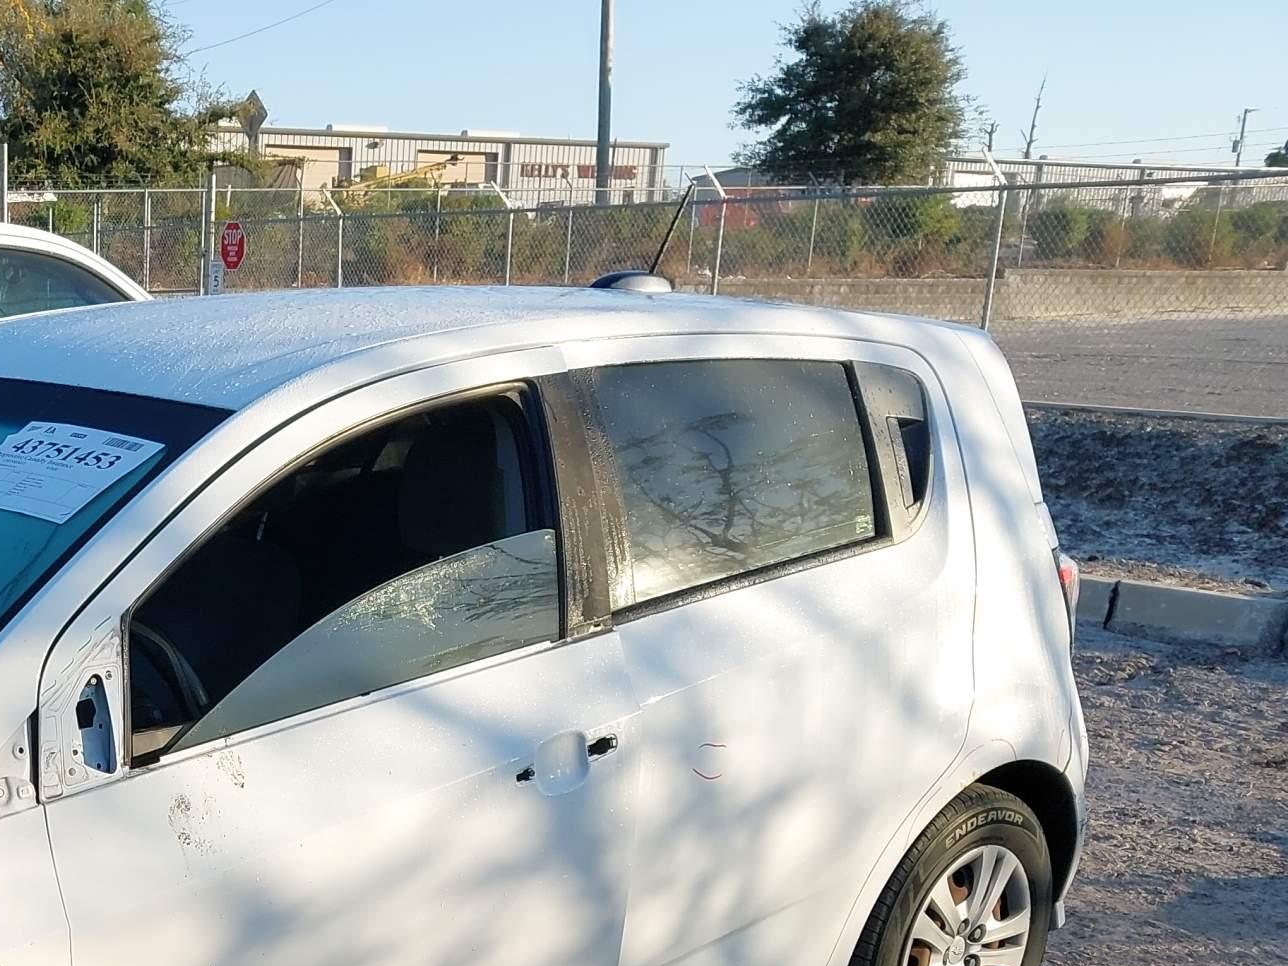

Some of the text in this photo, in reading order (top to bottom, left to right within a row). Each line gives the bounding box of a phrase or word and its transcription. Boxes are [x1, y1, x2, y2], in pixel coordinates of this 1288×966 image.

[223, 229, 242, 245] STOP
[213, 275, 220, 288] 5
[12, 438, 122, 470] 43751453
[945, 810, 1024, 849] ENDEAVOR
